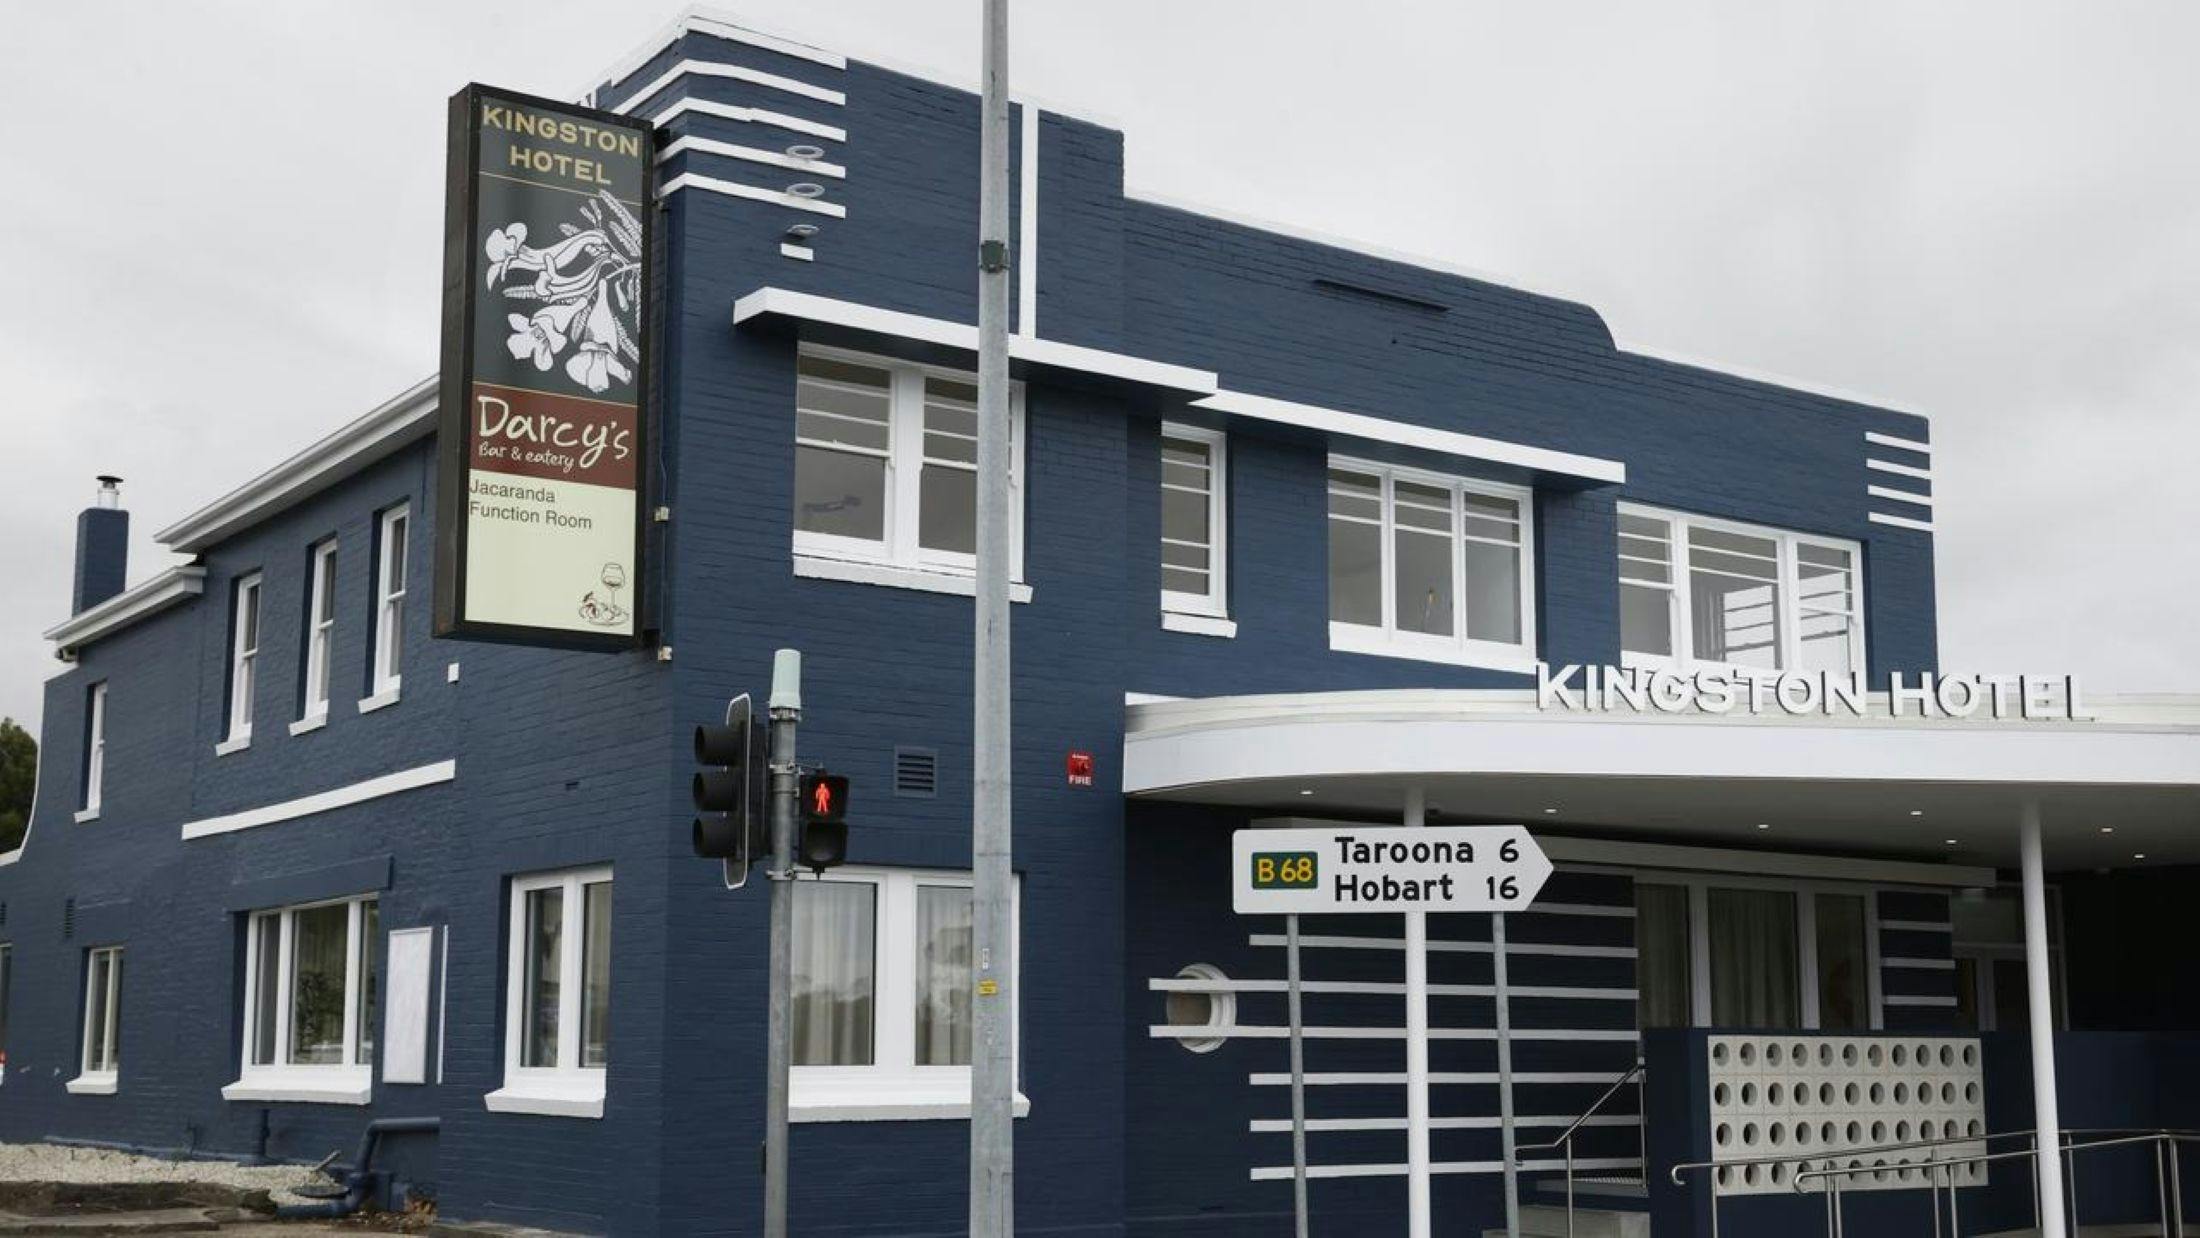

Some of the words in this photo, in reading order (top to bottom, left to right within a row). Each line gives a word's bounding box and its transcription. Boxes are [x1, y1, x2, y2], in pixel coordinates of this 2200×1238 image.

[482, 104, 638, 157] KINGSTON
[510, 145, 612, 184] HOTEL
[477, 395, 630, 468] Darcy's
[511, 446, 522, 460] &
[525, 449, 575, 473] eatery
[469, 479, 556, 503] Jacaranda
[469, 501, 540, 523] Function
[545, 509, 592, 529] Room
[1536, 662, 1867, 717] KINGSTON
[1889, 669, 2095, 721] HOTEL
[1334, 836, 1474, 864] Taroona
[1499, 838, 1520, 864] 6
[1257, 858, 1275, 883] B
[1280, 857, 1313, 883] 68
[1334, 874, 1454, 902] Hobart
[1486, 875, 1520, 900] 16
